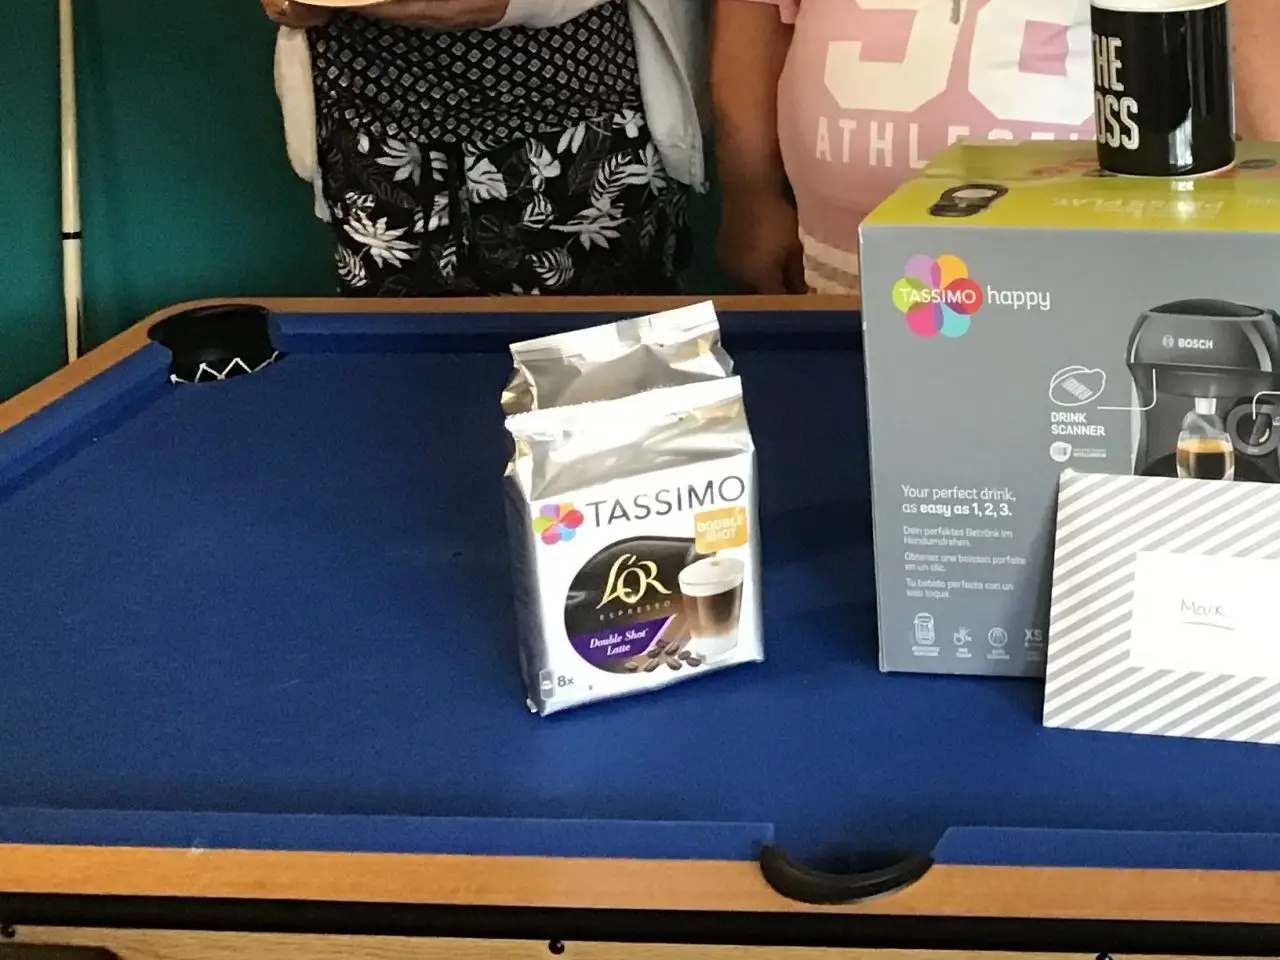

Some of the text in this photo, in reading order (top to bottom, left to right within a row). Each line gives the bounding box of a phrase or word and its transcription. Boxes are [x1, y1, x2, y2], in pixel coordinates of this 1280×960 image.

[1092, 32, 1125, 92] HE
[1095, 90, 1140, 151] OSS
[899, 284, 1051, 311] TASSIMO happy
[1177, 337, 1214, 350] BOSCH
[1050, 411, 1087, 424] DRINK
[1050, 424, 1106, 437] SCANNER
[584, 475, 746, 528] TASSIMO
[901, 483, 1017, 502] Your perfect drink,
[902, 502, 1013, 519] as easy as 1, 2, 3.
[696, 514, 744, 533] DOUBLE
[704, 527, 737, 542] SHOT
[595, 553, 673, 610] L'OR
[599, 600, 671, 621] ESPRESSO
[1180, 597, 1228, 618] Mark
[589, 628, 647, 649] Double Shot
[1024, 628, 1043, 642] XS
[606, 644, 631, 656] Latte
[557, 675, 575, 688] 8x
